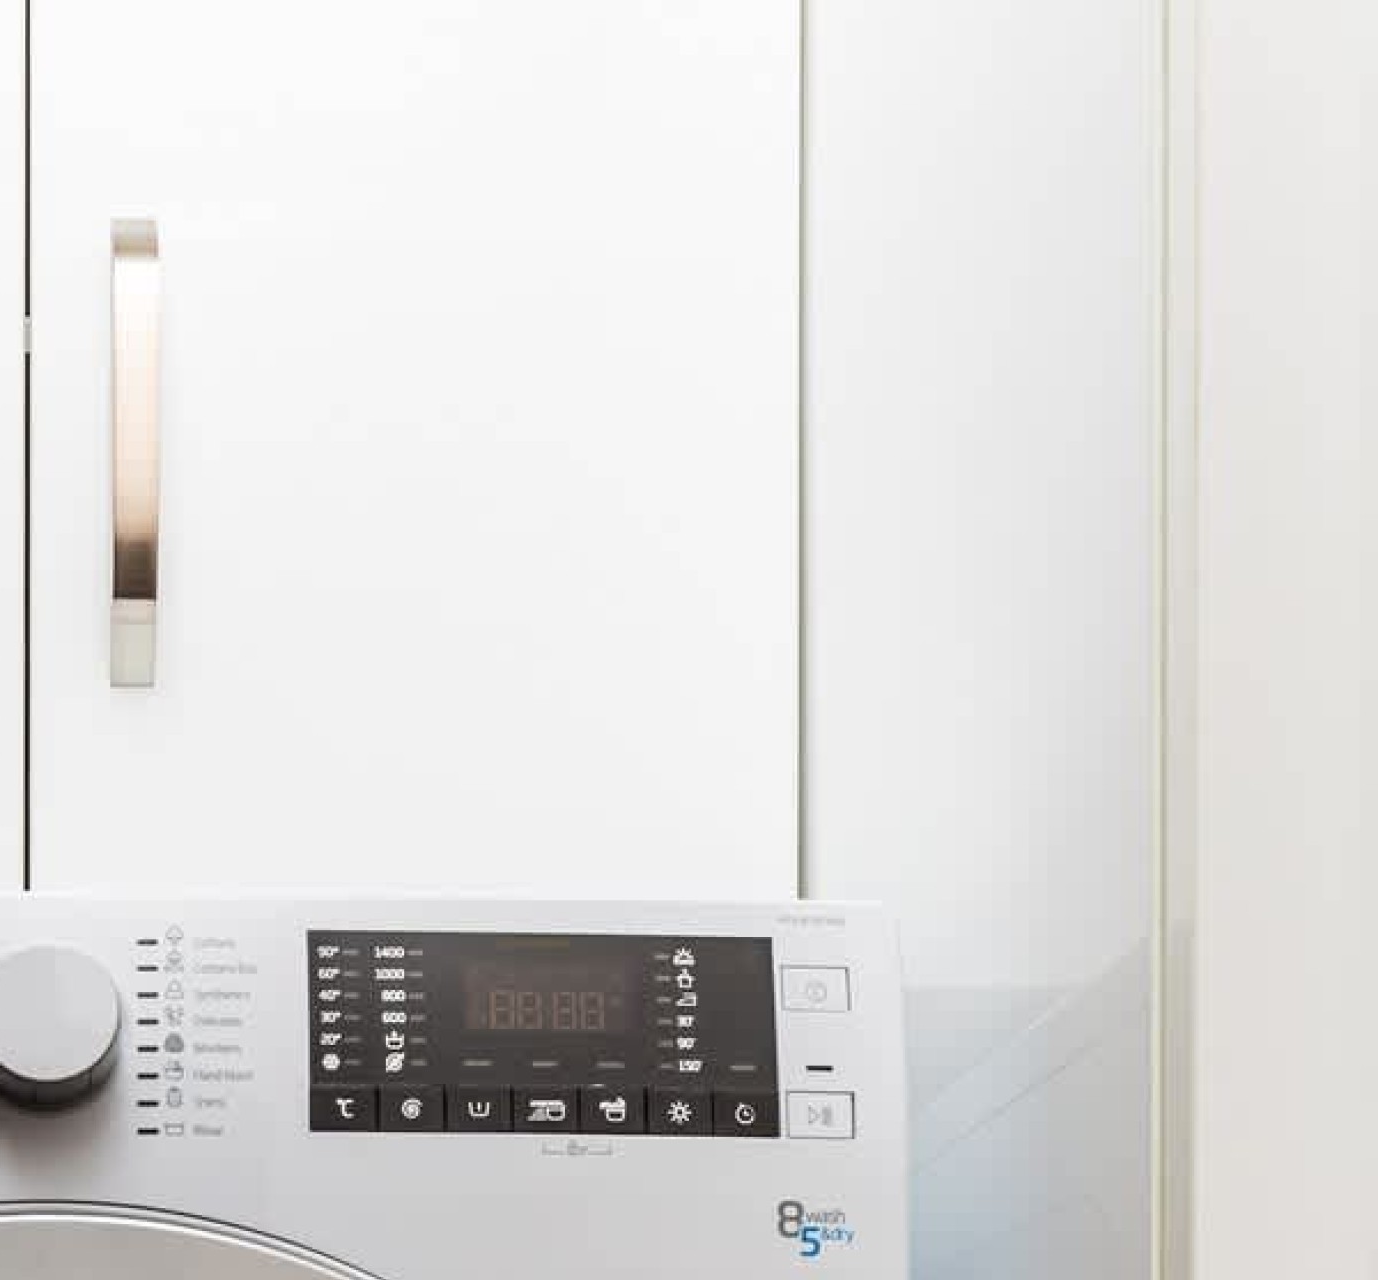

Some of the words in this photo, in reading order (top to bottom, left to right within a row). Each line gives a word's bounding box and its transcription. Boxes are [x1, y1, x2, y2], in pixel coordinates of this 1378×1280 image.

[374, 945, 404, 958] 1400
[374, 968, 404, 980] 1000
[778, 1200, 803, 1239] 8
[800, 1226, 821, 1256] 5
